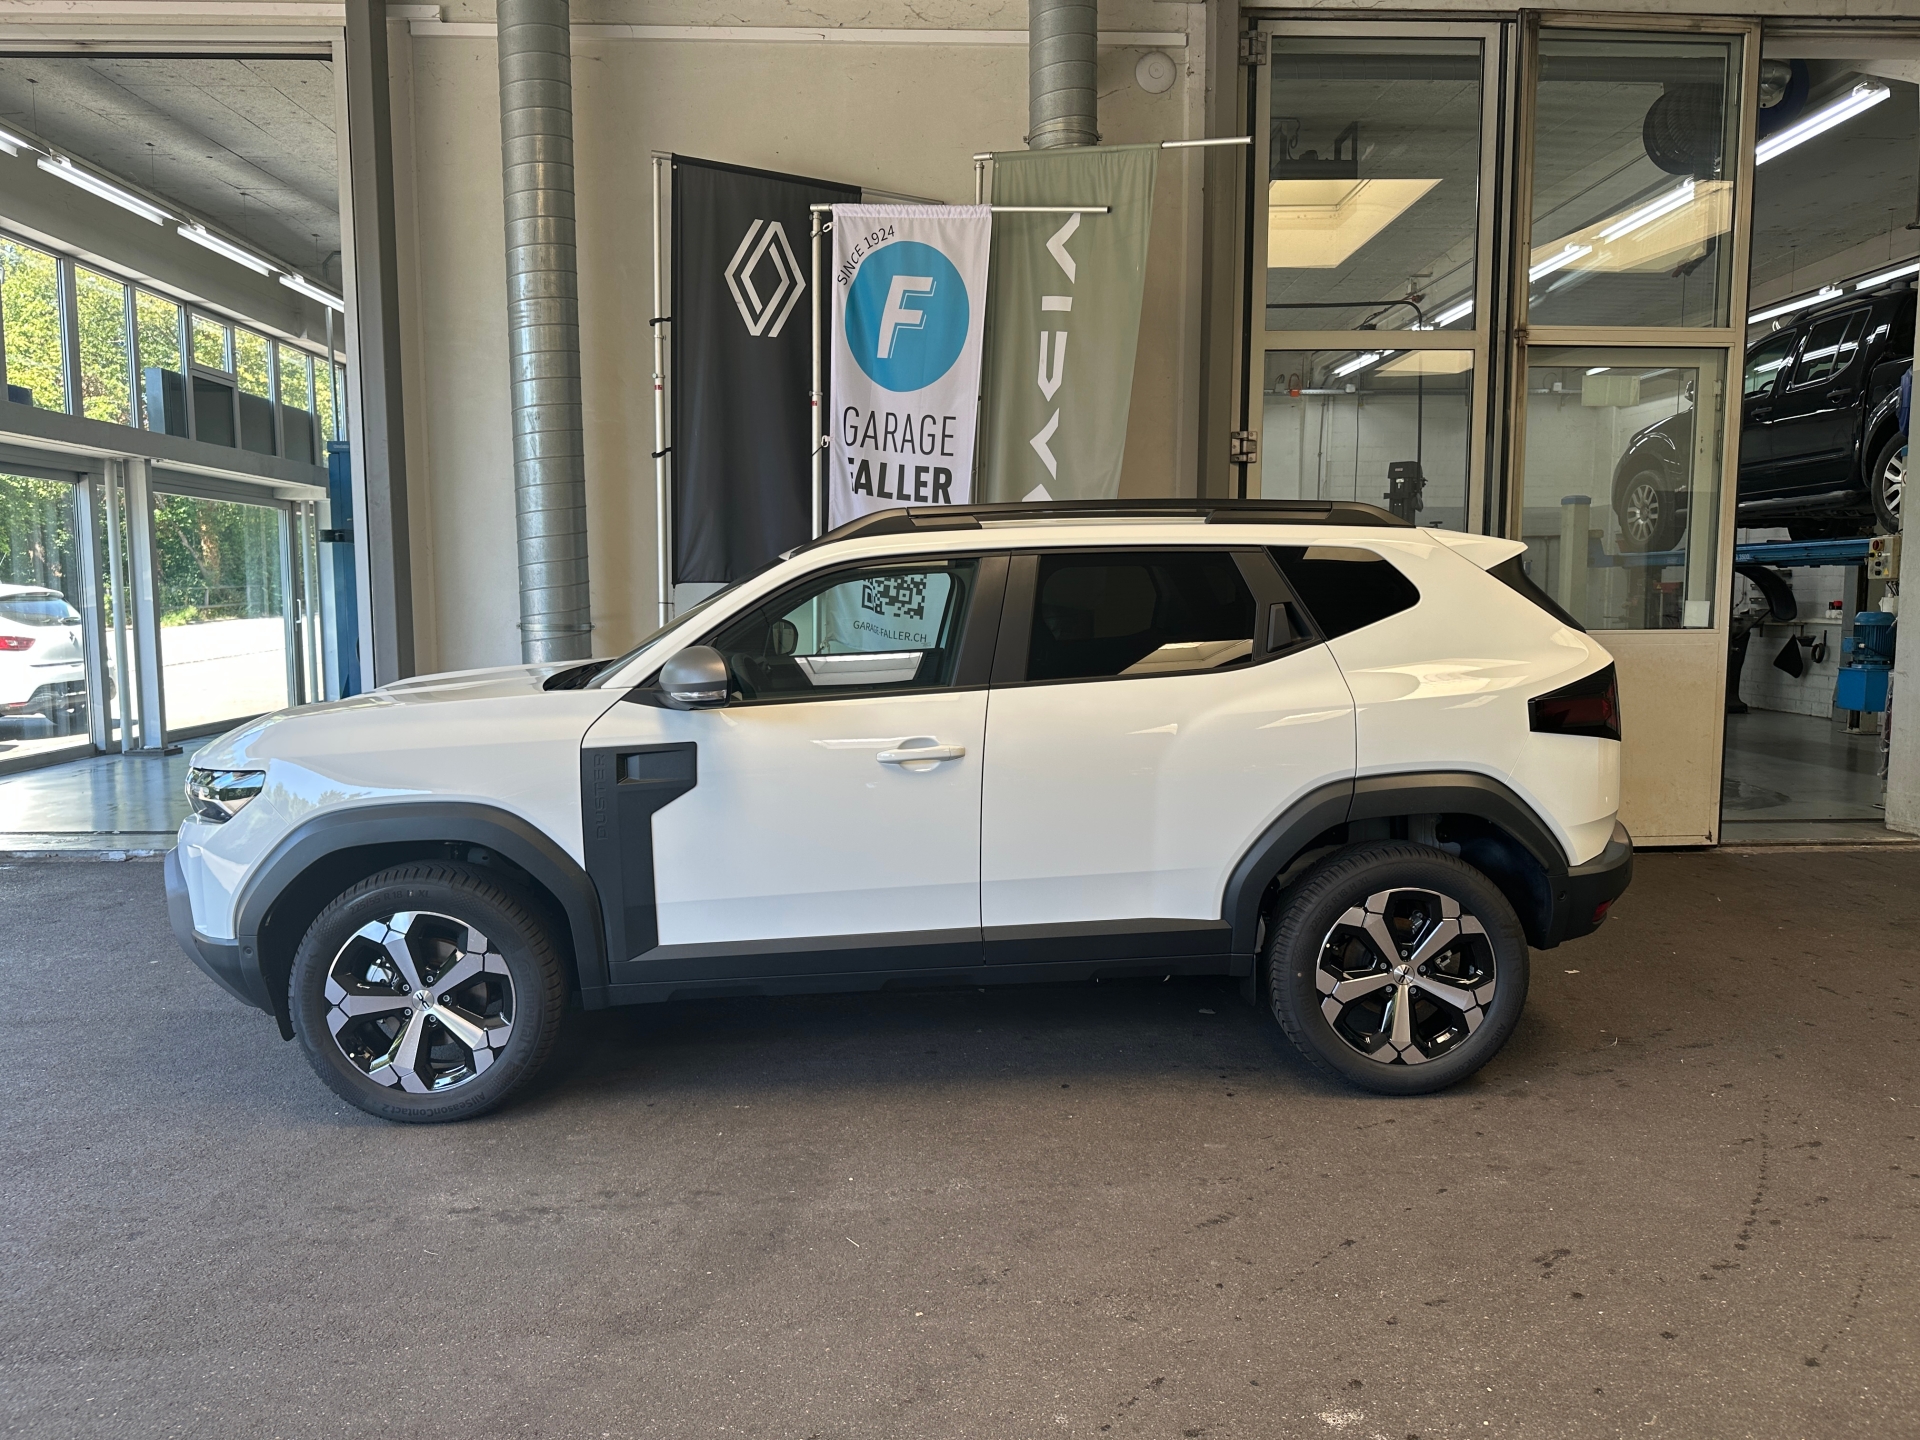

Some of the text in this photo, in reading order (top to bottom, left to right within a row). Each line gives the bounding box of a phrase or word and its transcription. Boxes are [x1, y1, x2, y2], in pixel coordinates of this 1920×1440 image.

[837, 224, 895, 286] SINCE 1924
[876, 275, 937, 359] F
[1022, 212, 1081, 501] ACIA
[843, 406, 957, 457] GARAGE
[593, 753, 609, 841] DUSTER
[348, 896, 381, 915] 225/55
[383, 892, 391, 901] R
[392, 890, 403, 899] 18
[418, 889, 431, 898] XL
[1308, 902, 1333, 932] 225/55
[1331, 896, 1339, 904] R
[1337, 888, 1349, 899] 18
[1358, 876, 1370, 887] XL
[1432, 1022, 1507, 1081] AllSeasonContact
[381, 1091, 486, 1118] AllSeasonContact 2
